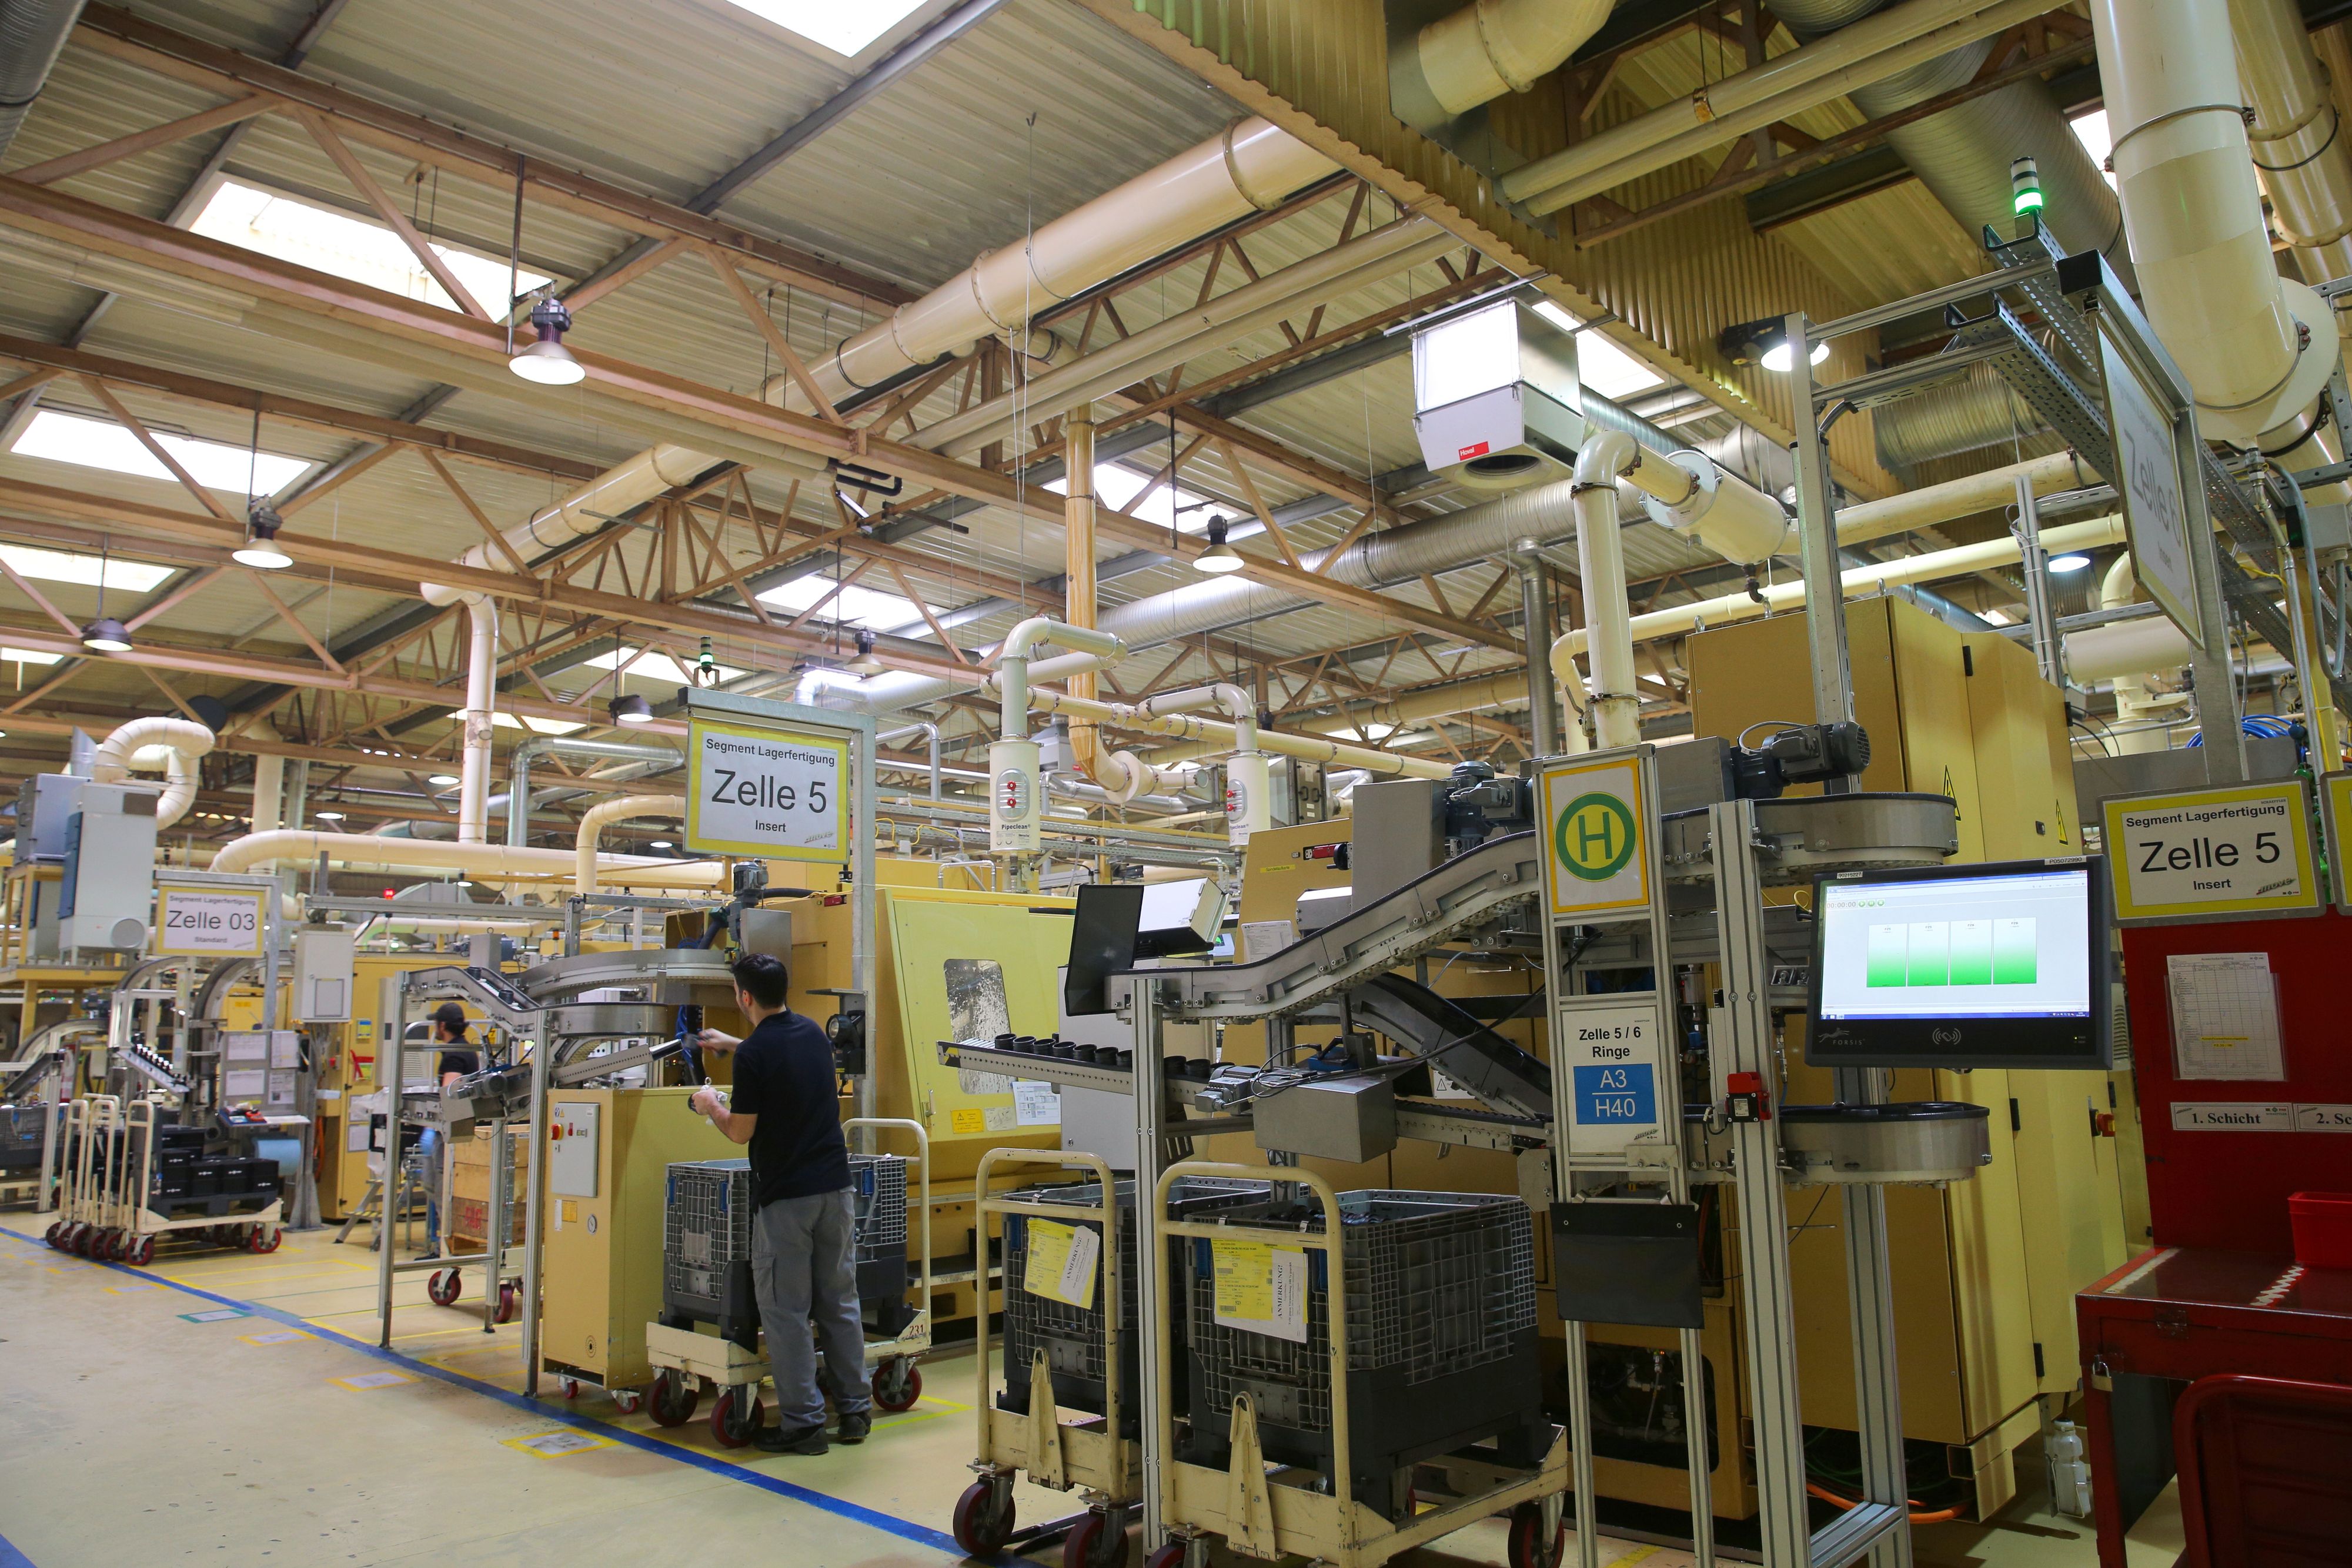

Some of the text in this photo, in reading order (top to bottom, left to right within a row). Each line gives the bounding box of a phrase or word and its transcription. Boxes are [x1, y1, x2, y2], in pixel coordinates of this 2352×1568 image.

[1459, 446, 1475, 456] Hoval
[2124, 428, 2169, 531] Zelle
[706, 738, 835, 767] Segment Lagerfertigung
[712, 769, 827, 814] Zelle 5
[2126, 805, 2285, 828] Segment Lagerfertigung
[756, 820, 786, 833] Insert
[2139, 831, 2280, 873] Zelle 5
[2193, 879, 2231, 890] Insert
[167, 910, 255, 931] Zelle 03
[1579, 1026, 1641, 1041] Zelle 5 / 6
[1592, 1046, 1631, 1059] Ringe
[1600, 1069, 1627, 1088] A3
[1595, 1098, 1636, 1118] H40
[2192, 1112, 2261, 1124] 1. Schicht
[2316, 1113, 2329, 1124] 2.
[909, 1324, 923, 1336] 231
